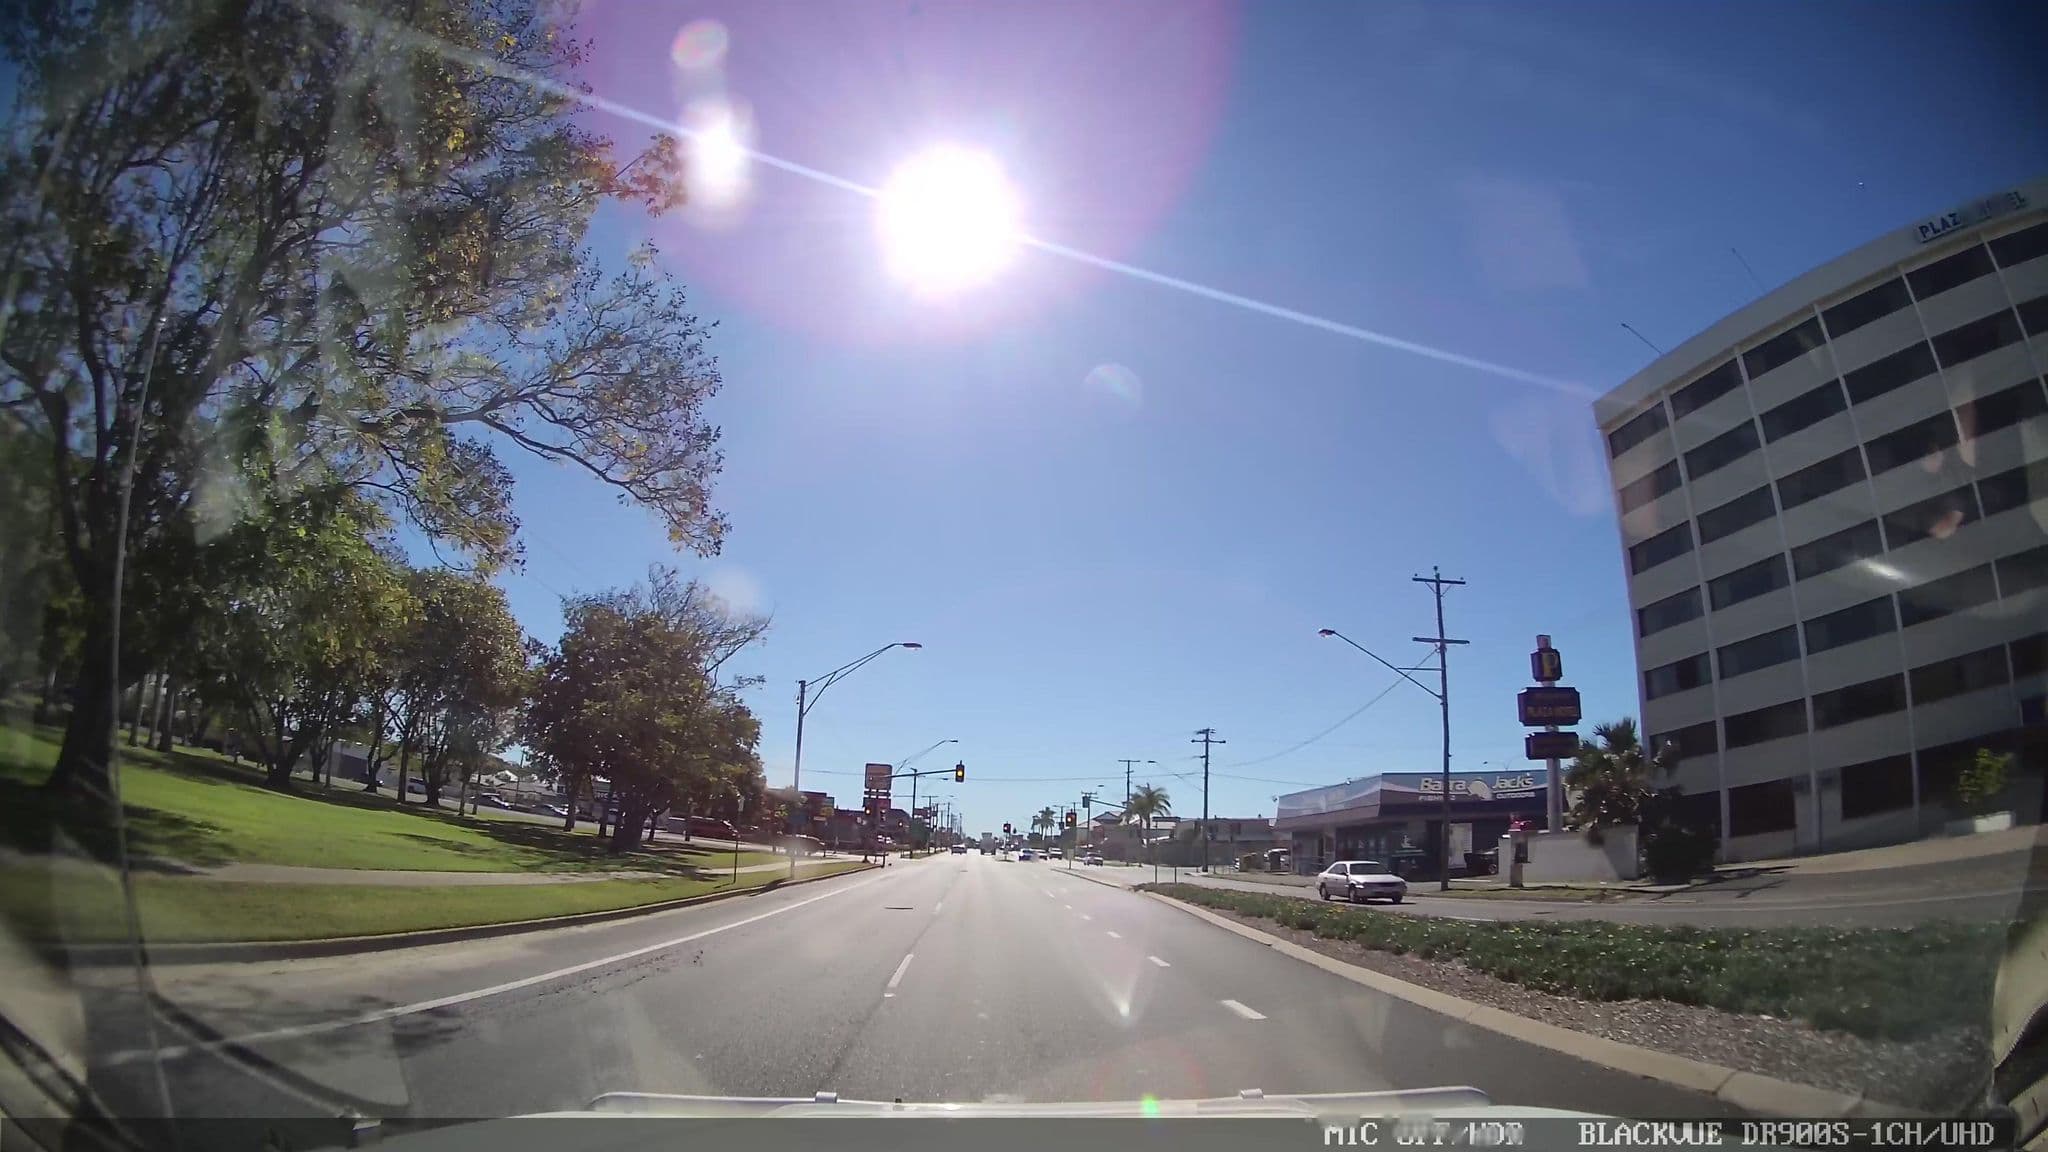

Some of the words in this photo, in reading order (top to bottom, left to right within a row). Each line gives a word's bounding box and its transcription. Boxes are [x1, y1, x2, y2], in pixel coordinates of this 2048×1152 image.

[1917, 212, 1967, 239] PLAZ
[1420, 777, 1466, 791] Bara
[1491, 772, 1535, 789] Jack's
